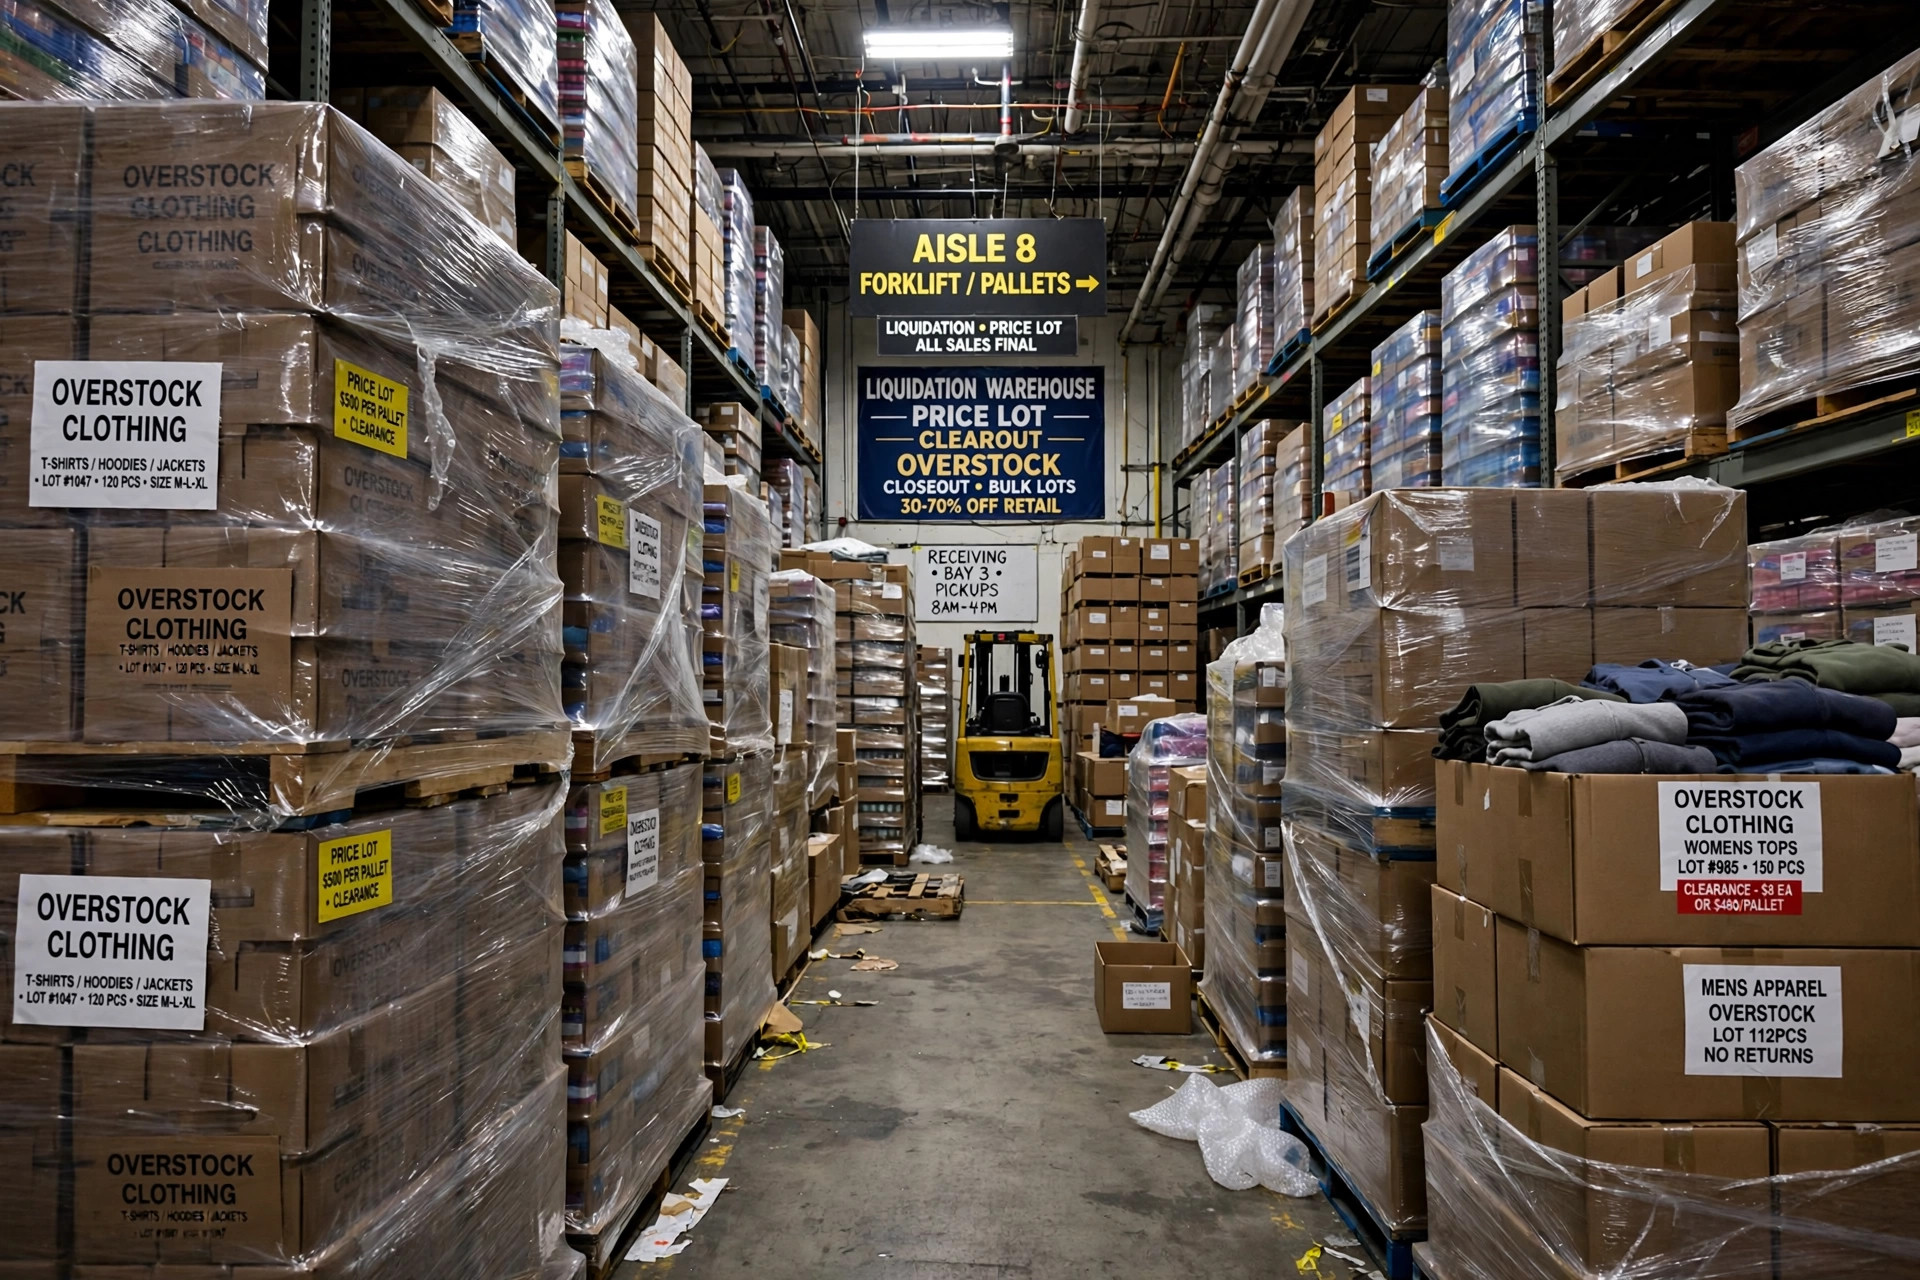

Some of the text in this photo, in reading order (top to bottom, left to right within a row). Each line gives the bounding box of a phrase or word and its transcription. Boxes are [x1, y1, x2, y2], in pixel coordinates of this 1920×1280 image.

[123, 163, 275, 188] OVERSTOCK
[138, 230, 253, 253] CLOTHING
[912, 233, 1037, 264] AISLE 8
[860, 271, 962, 295] FORKLIFT
[980, 271, 1071, 295] PALLETS
[885, 320, 1063, 337] LIQUIDATION PRICE LOT
[915, 337, 1037, 352] ALL SALES FINAL
[52, 378, 203, 407] OVERSTOCK
[347, 370, 395, 403] PRICE LOT
[866, 377, 1096, 402] LIQUIDATION WAREHOUSE
[339, 391, 405, 428] $500 PER PALLET
[912, 404, 1046, 427] PRICE LOT
[62, 414, 187, 442] CLOTHING
[350, 415, 396, 446] CLEARANCE
[919, 430, 1043, 449] CLEAROUT
[41, 457, 89, 471] T-SHIRTS
[98, 458, 147, 471] HOODIES
[156, 459, 206, 472] JACKETS
[897, 453, 1061, 476] OVERSTOCK
[42, 475, 208, 489] LOT #1047 120 PCS SIZE M-L-XL
[883, 479, 1076, 495] CLOSEOUT BULK LOTS
[900, 498, 1062, 514] 30-70% OFF RETAIL
[928, 549, 1007, 564] RECEIVING
[944, 566, 990, 581] BAY 3
[117, 587, 265, 611] OVERSTOCK
[935, 583, 999, 597] PICKUPS
[126, 617, 247, 640] CLOTHING
[1674, 789, 1804, 809] OVERSTOCK
[1686, 815, 1794, 834] CLOTHING
[331, 840, 378, 865] PRICE LOT
[1684, 840, 1798, 855] WOMENS TOPS
[343, 865, 360, 885] PER
[361, 859, 389, 880] PALLET
[1678, 860, 1805, 875] LOT #985 150 PCS
[333, 882, 379, 909] CLEARANCE
[1684, 883, 1751, 896] CLEARANCE
[1777, 883, 1793, 896] EA
[37, 892, 191, 925] OVERSTOCK
[1694, 898, 1711, 911] OR
[47, 930, 175, 961] CLOTHING
[25, 974, 75, 988] T-SHIRTS
[83, 975, 134, 990] HOODIES
[143, 977, 193, 991] JACKETS
[1701, 978, 1827, 998] MENS APPAREL
[26, 991, 196, 1009] LOT #1047 120 PCS SIZE M-L-XL
[1708, 1003, 1816, 1023] OVERSTOCK
[1713, 1027, 1807, 1043] LOT 112PCS
[1704, 1047, 1814, 1064] NO RETURNS
[107, 1153, 255, 1177] OVERSTOCK
[122, 1183, 237, 1206] CLOTHING
